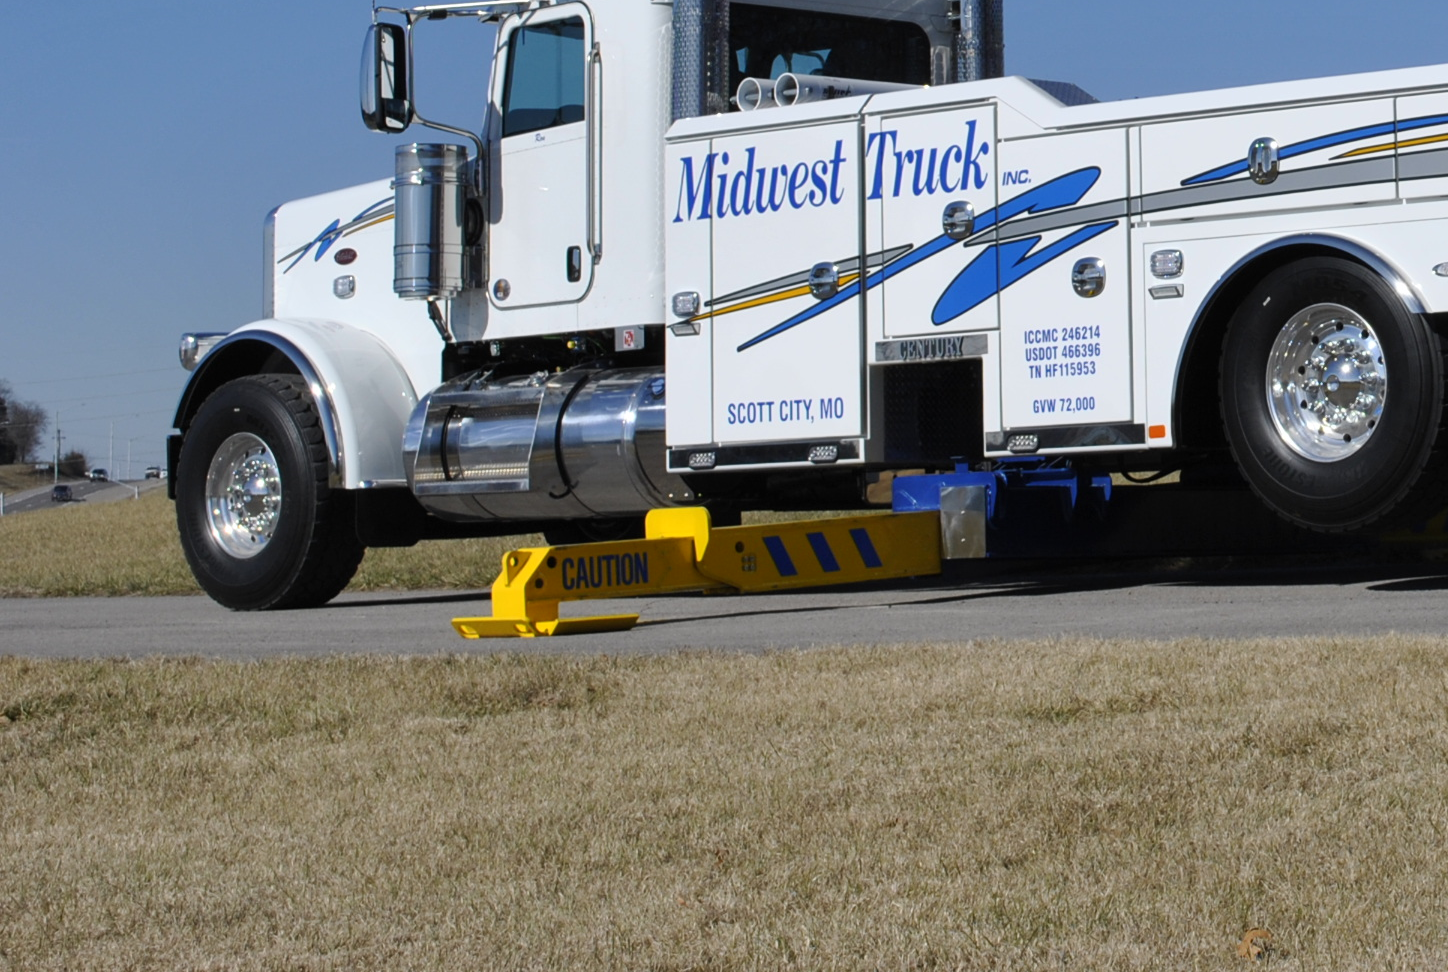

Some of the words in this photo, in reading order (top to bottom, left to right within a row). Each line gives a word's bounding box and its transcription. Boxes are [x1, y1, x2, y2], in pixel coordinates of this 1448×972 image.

[671, 139, 847, 223] Midwest
[865, 119, 989, 201] Truck
[1001, 168, 1032, 187] INC.
[1024, 327, 1059, 345] ICCMC
[1061, 324, 1101, 342] 246214
[899, 336, 965, 361] CENTURY
[1025, 345, 1059, 362] USDOT
[1061, 342, 1101, 359] 466396
[1028, 364, 1042, 379] TN
[1044, 360, 1096, 378] HF115953
[727, 401, 775, 425] SCOTT
[779, 399, 815, 423] CITY,
[819, 397, 845, 420] MO
[1032, 398, 1057, 414] GVW
[1059, 396, 1096, 413] 72,000
[561, 552, 649, 590] CAUTION
